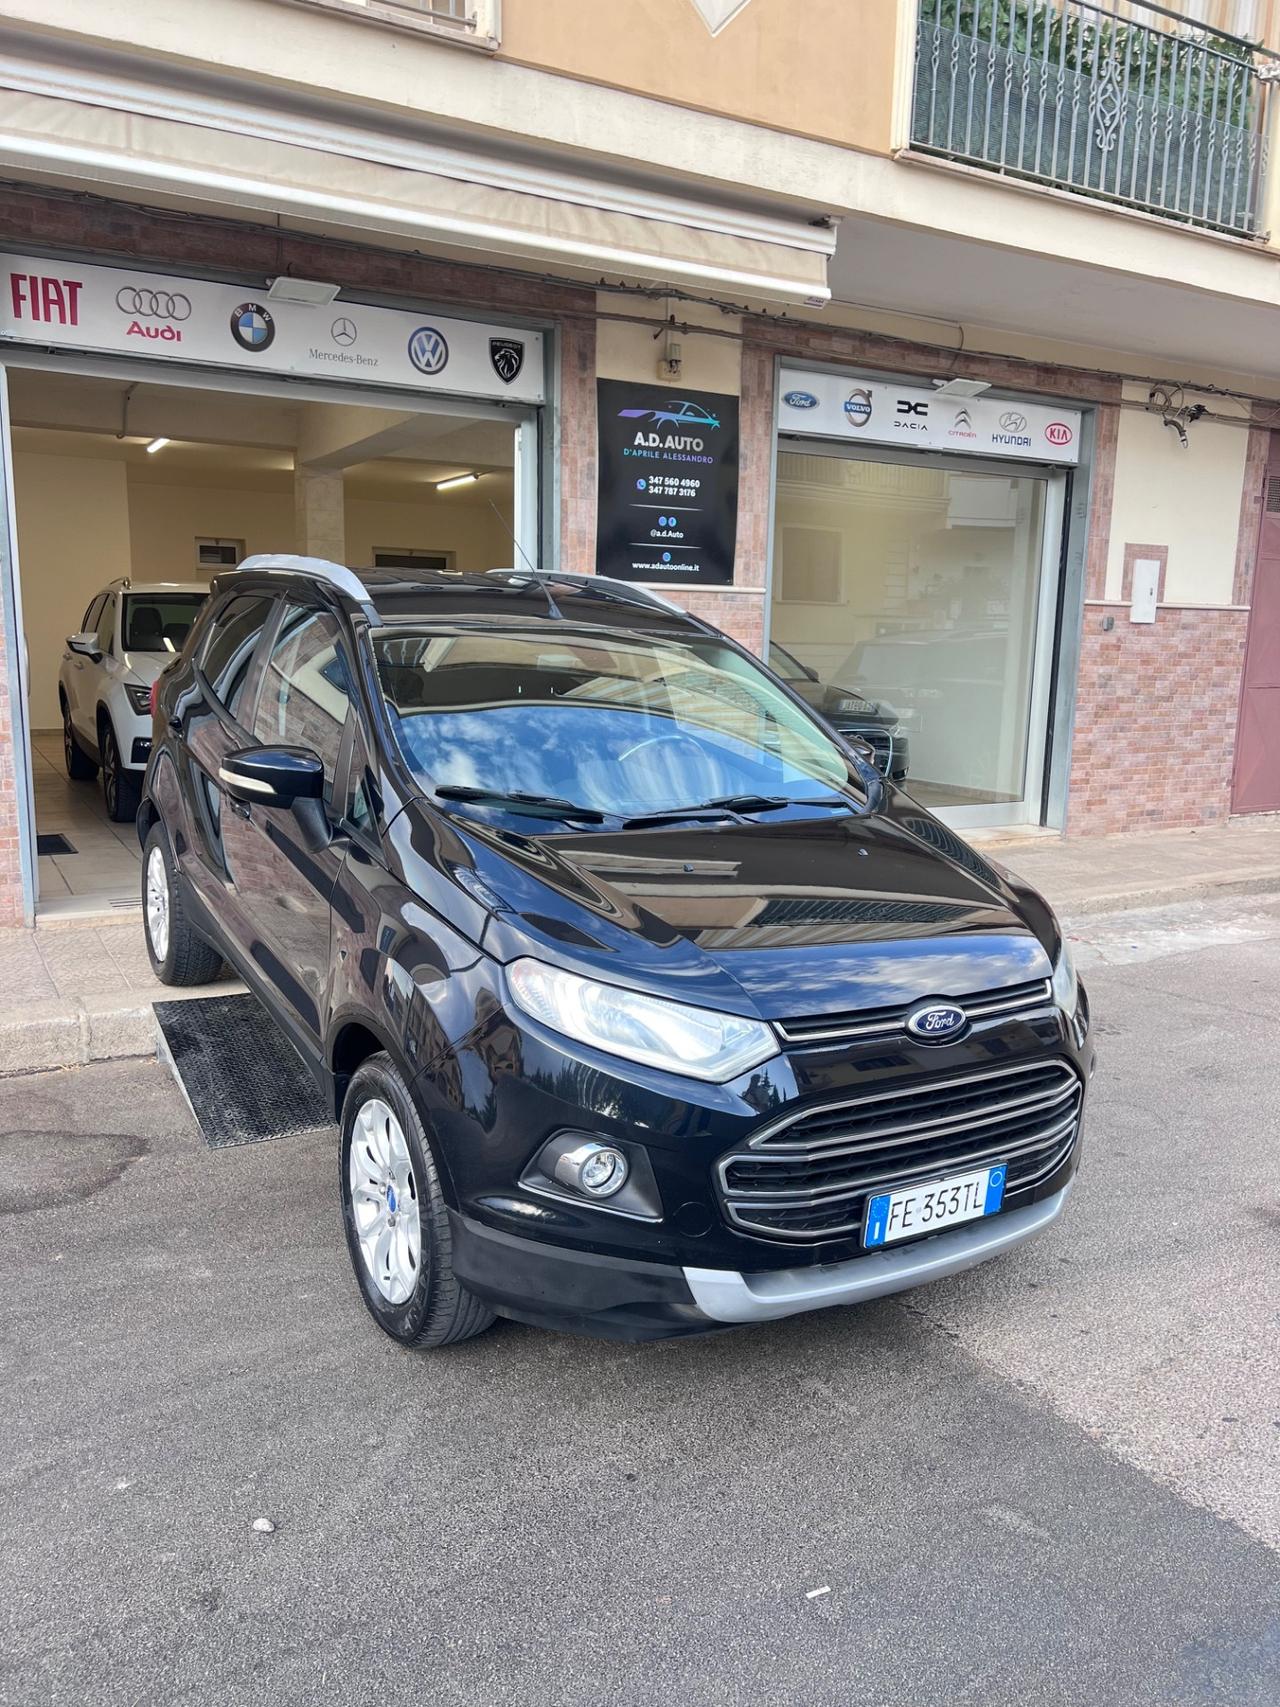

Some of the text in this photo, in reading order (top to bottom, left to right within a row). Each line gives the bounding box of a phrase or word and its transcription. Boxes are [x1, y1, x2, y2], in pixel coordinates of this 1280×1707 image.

[10, 273, 83, 326] FIAT
[234, 303, 272, 322] BMW
[126, 321, 182, 342] Audi
[309, 348, 378, 367] Mercedes-Benz
[789, 393, 811, 407] Ford
[846, 403, 871, 413] VOLVO
[893, 421, 928, 431] DACIA
[992, 434, 1032, 447] HYUNDAI
[1049, 427, 1068, 441] KIA
[623, 448, 714, 464] D'APRILE ALESSANDRO
[648, 475, 701, 488] 347 560 4960
[648, 485, 696, 497] 347 787 3176
[650, 529, 684, 539] @a.d.Auto
[632, 562, 700, 572] www.adautoonline.it
[925, 1010, 955, 1030] Ford
